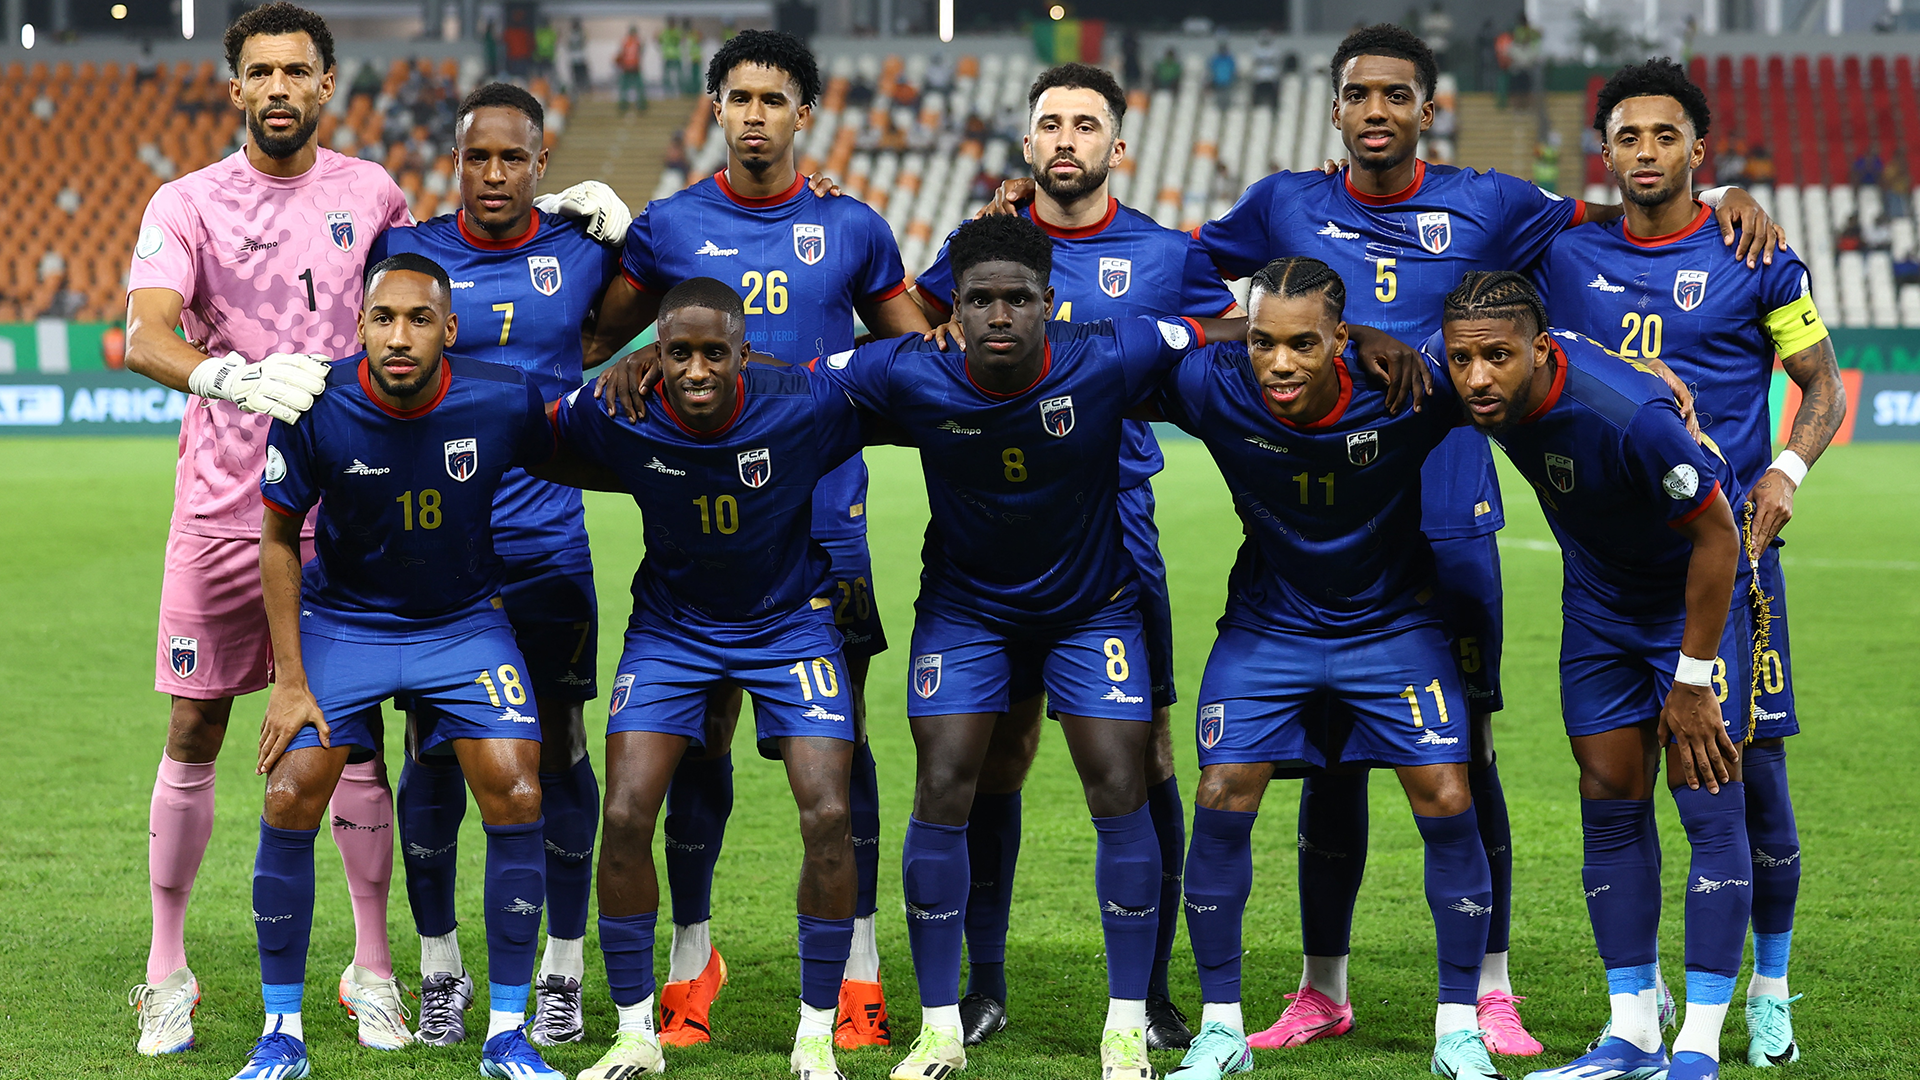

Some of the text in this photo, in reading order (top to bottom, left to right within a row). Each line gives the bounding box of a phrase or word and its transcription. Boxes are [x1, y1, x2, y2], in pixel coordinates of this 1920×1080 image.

[327, 212, 349, 221] FCF
[1420, 214, 1446, 223] FCF
[1331, 230, 1360, 240] tempo
[250, 240, 278, 252] tempo
[709, 246, 739, 257] tempo
[530, 257, 555, 265] FCF
[1102, 259, 1128, 268] FCF
[1374, 258, 1397, 303] 5
[1679, 272, 1705, 280] FCF
[298, 268, 317, 312] 1
[741, 270, 789, 315] 26
[1600, 283, 1625, 294] tempo
[492, 302, 514, 346] 7
[770, 330, 799, 342] VERDE
[1620, 311, 1663, 359] 20
[69, 387, 186, 423] AFRICA
[1042, 398, 1069, 410] FCF
[952, 426, 982, 436] tempo
[1348, 432, 1376, 443] FCF
[446, 440, 474, 451] FCF
[1259, 441, 1289, 454] tempo
[739, 450, 766, 461] FCF
[1001, 447, 1028, 483] 8
[359, 467, 390, 476] tempo
[657, 466, 686, 477] tempo
[1292, 471, 1335, 506] 11
[396, 488, 443, 531] 18
[693, 494, 739, 535] 10
[834, 576, 870, 626] 26
[171, 637, 195, 646] FCF
[569, 621, 590, 664] 7
[916, 656, 940, 665] FCF
[1103, 637, 1130, 682] 8
[1459, 635, 1481, 674] 5
[474, 663, 527, 707] 18
[788, 656, 840, 702] 10
[1116, 694, 1144, 704] tempo
[1399, 678, 1449, 728] 11
[817, 712, 846, 722] tempo
[1758, 711, 1787, 721] tempo
[1431, 735, 1459, 745] tempo
